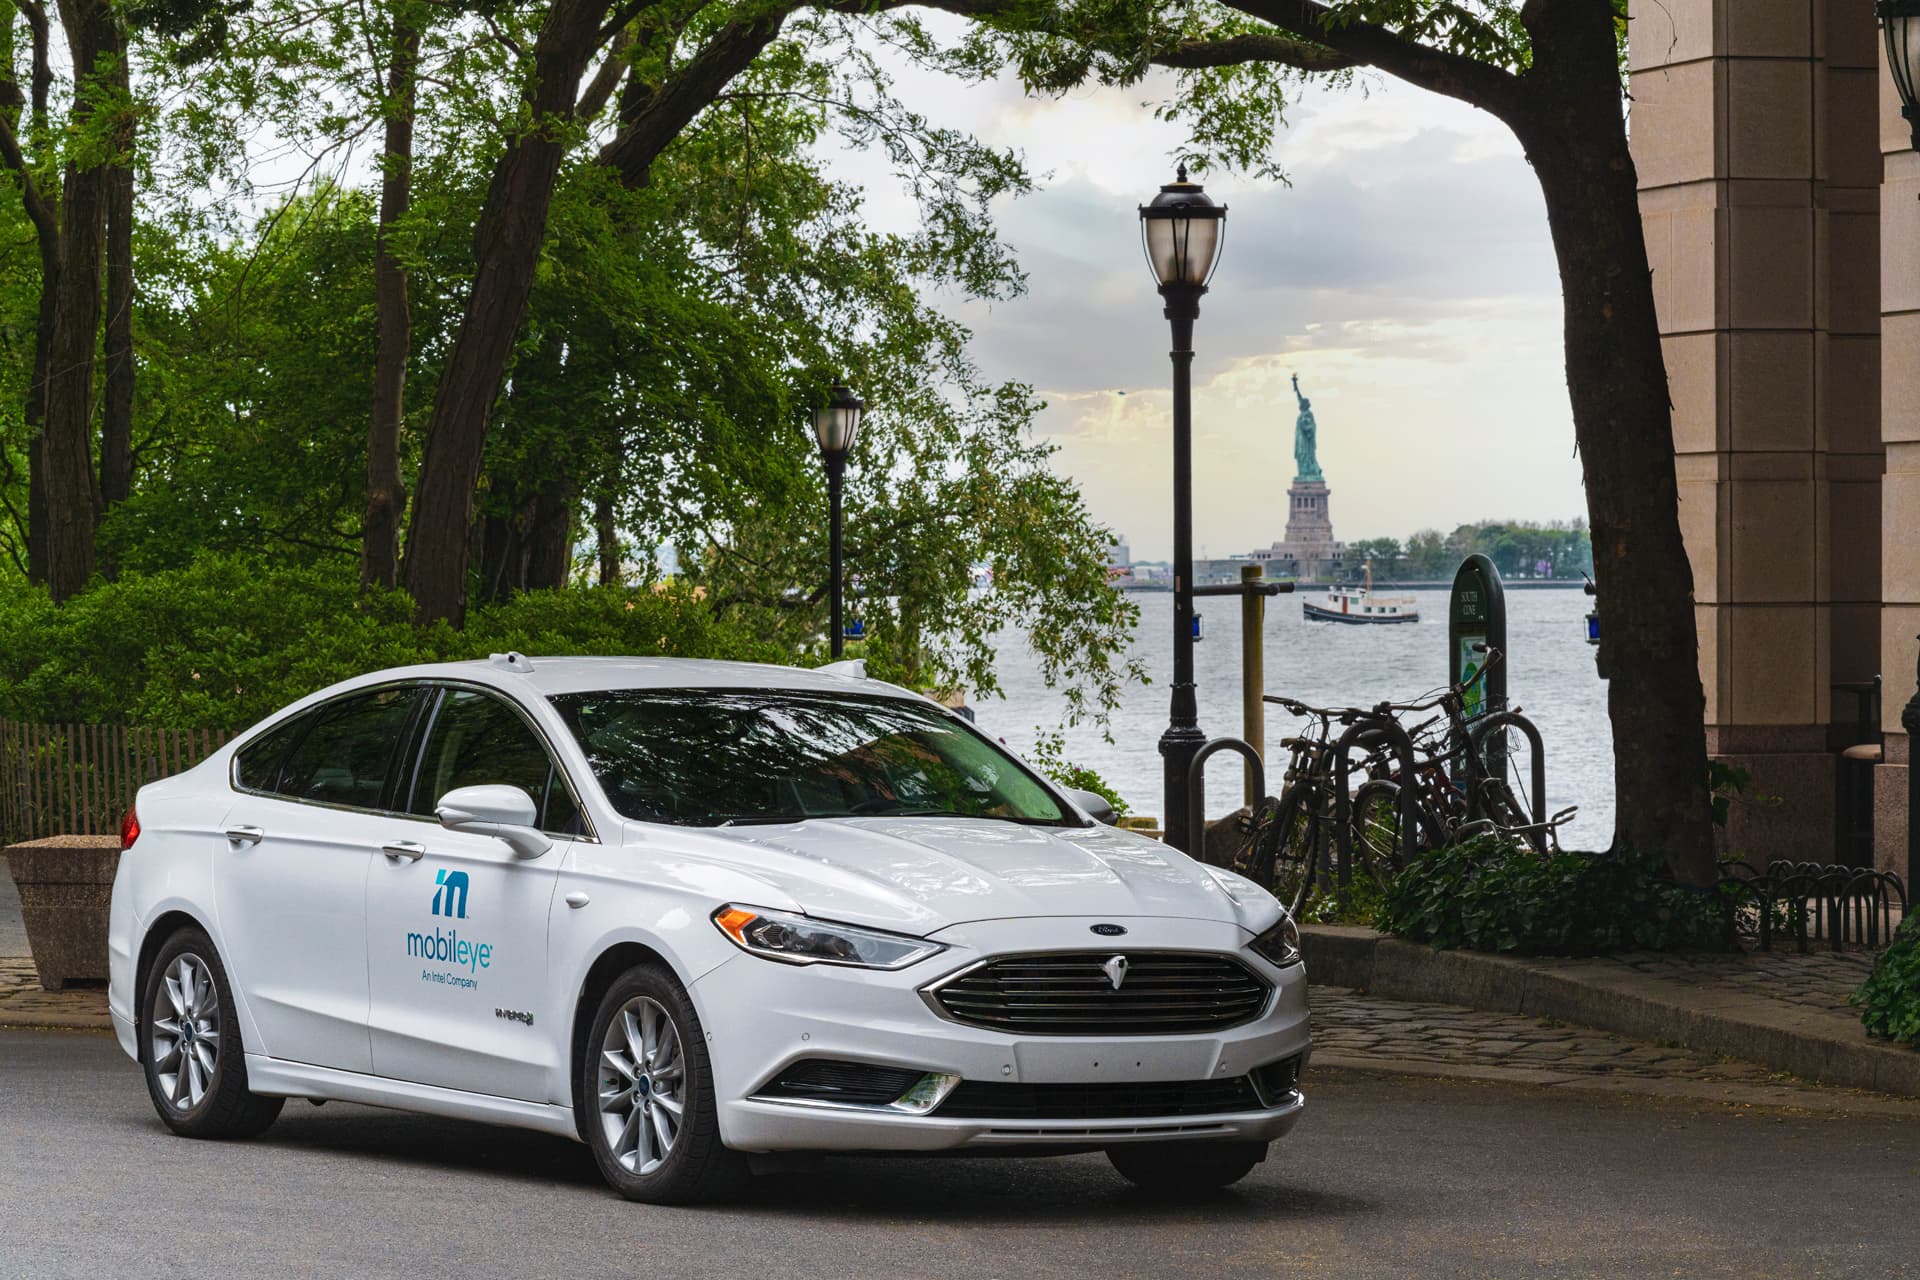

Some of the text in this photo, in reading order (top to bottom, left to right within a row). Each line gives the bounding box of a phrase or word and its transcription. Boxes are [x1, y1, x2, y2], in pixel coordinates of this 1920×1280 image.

[407, 927, 492, 974] mobileye
[422, 970, 477, 991] An Intel Company
